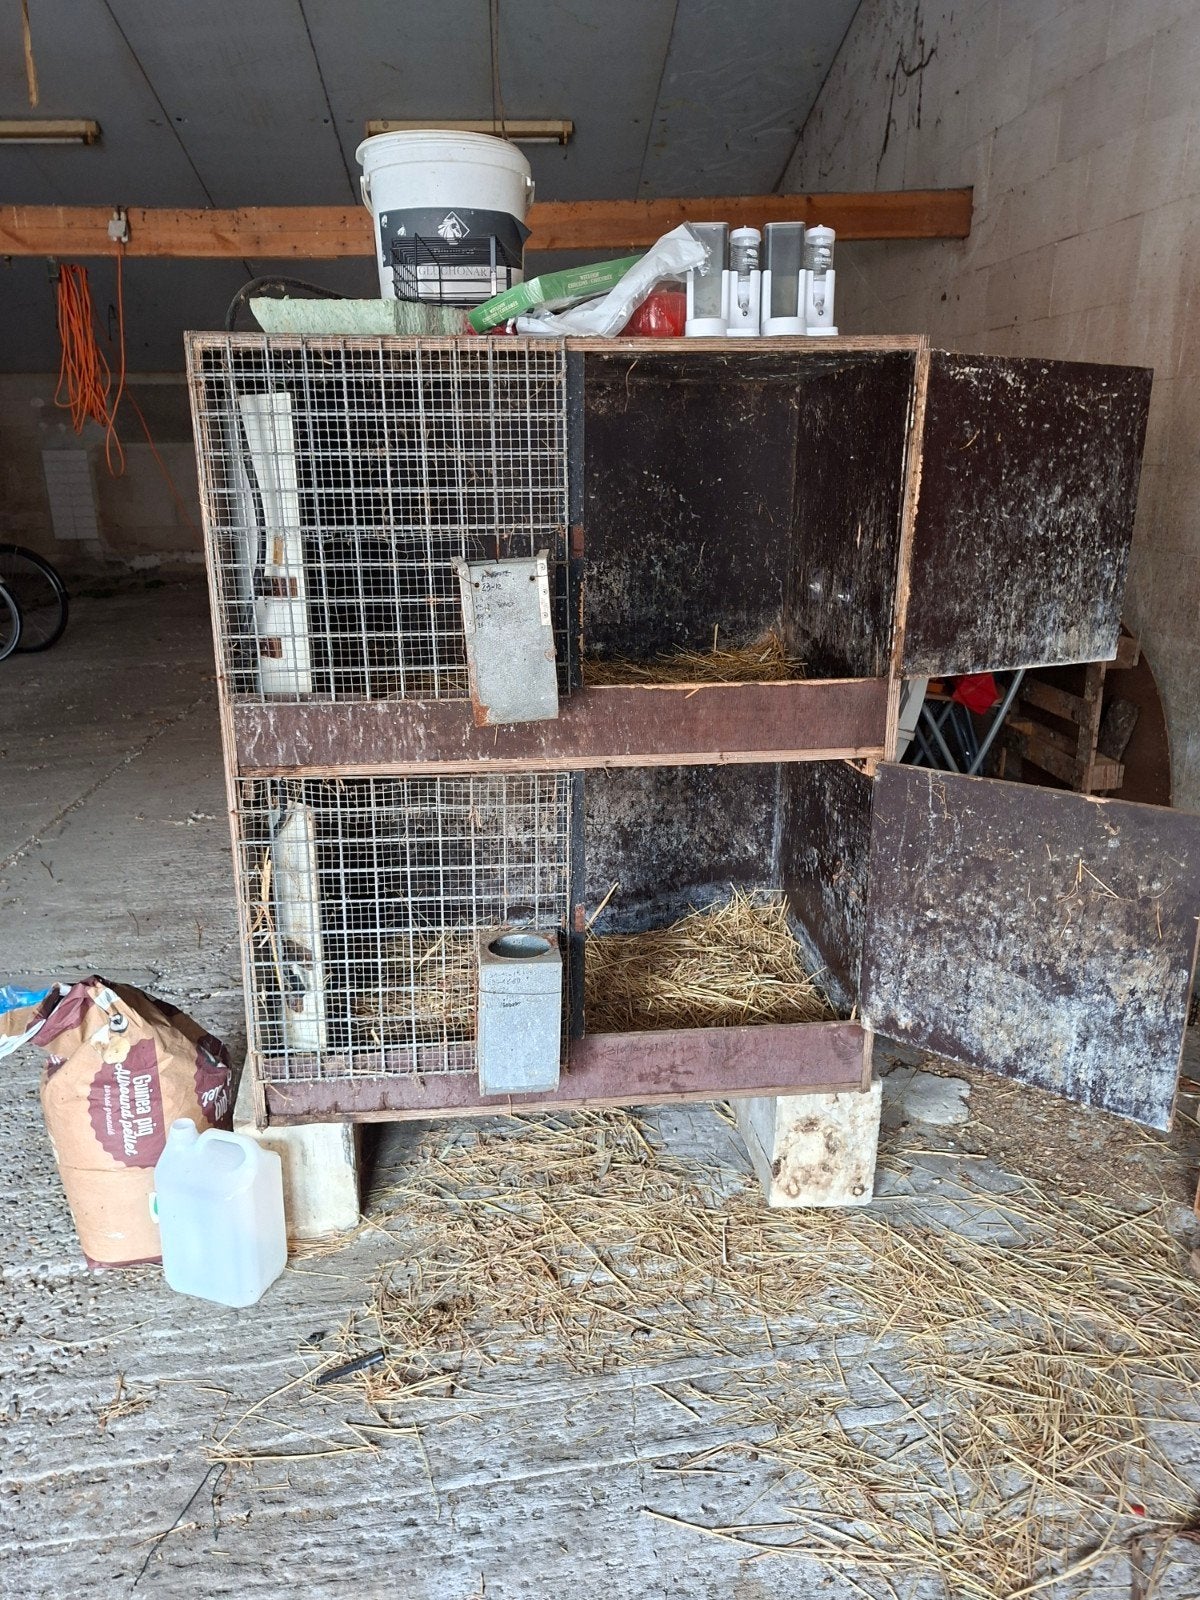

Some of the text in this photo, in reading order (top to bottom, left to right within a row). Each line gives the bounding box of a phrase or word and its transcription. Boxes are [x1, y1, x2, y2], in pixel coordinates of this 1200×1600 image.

[113, 1062, 138, 1156] Allround pellet
[132, 1074, 156, 1137] Guinea pig
